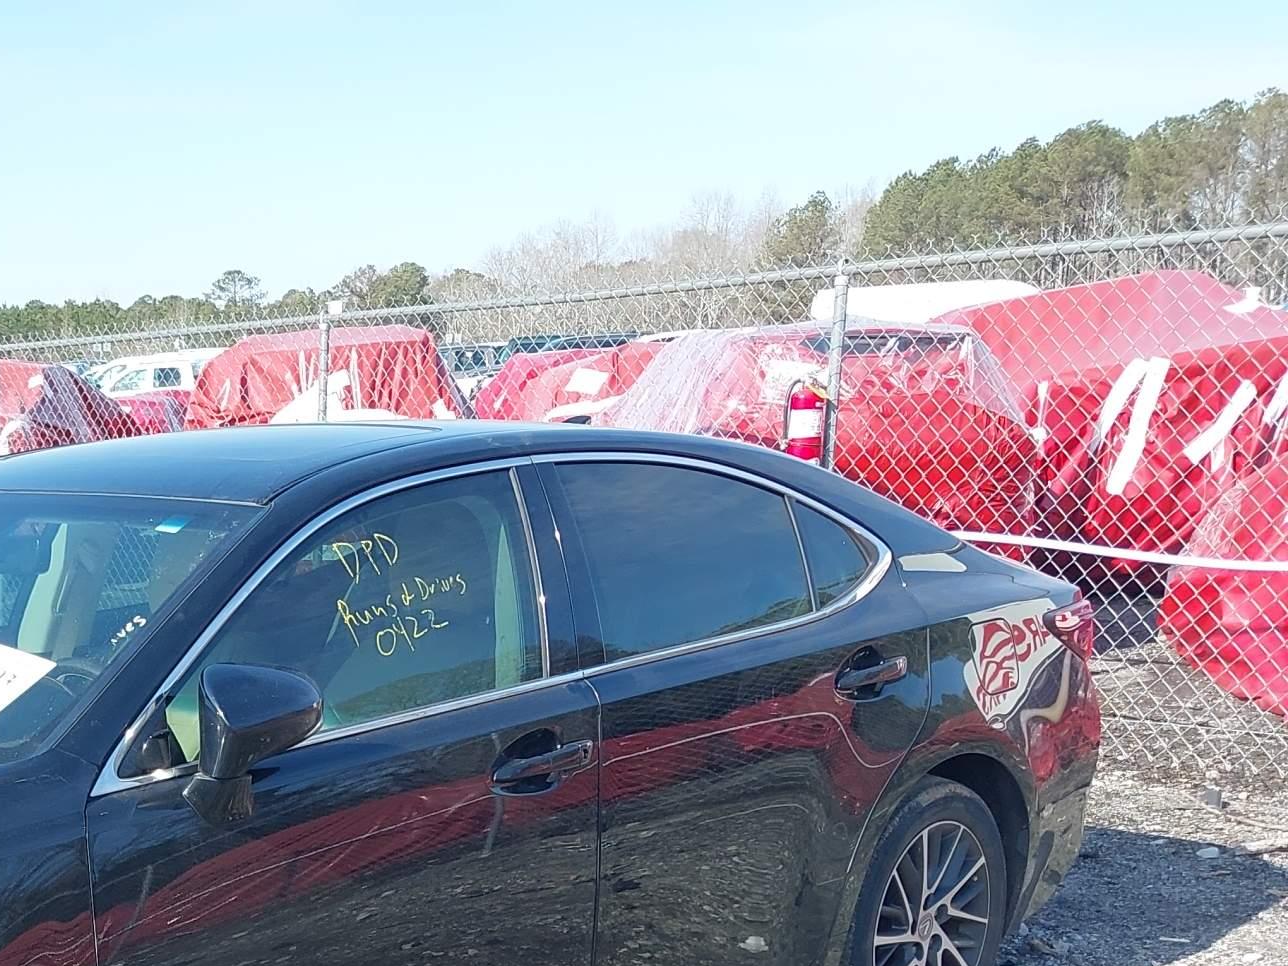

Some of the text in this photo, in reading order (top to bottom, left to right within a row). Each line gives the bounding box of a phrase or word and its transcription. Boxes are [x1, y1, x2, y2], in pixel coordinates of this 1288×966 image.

[332, 532, 400, 584] DPD
[336, 597, 398, 648] Runs
[375, 609, 449, 657] 0422
